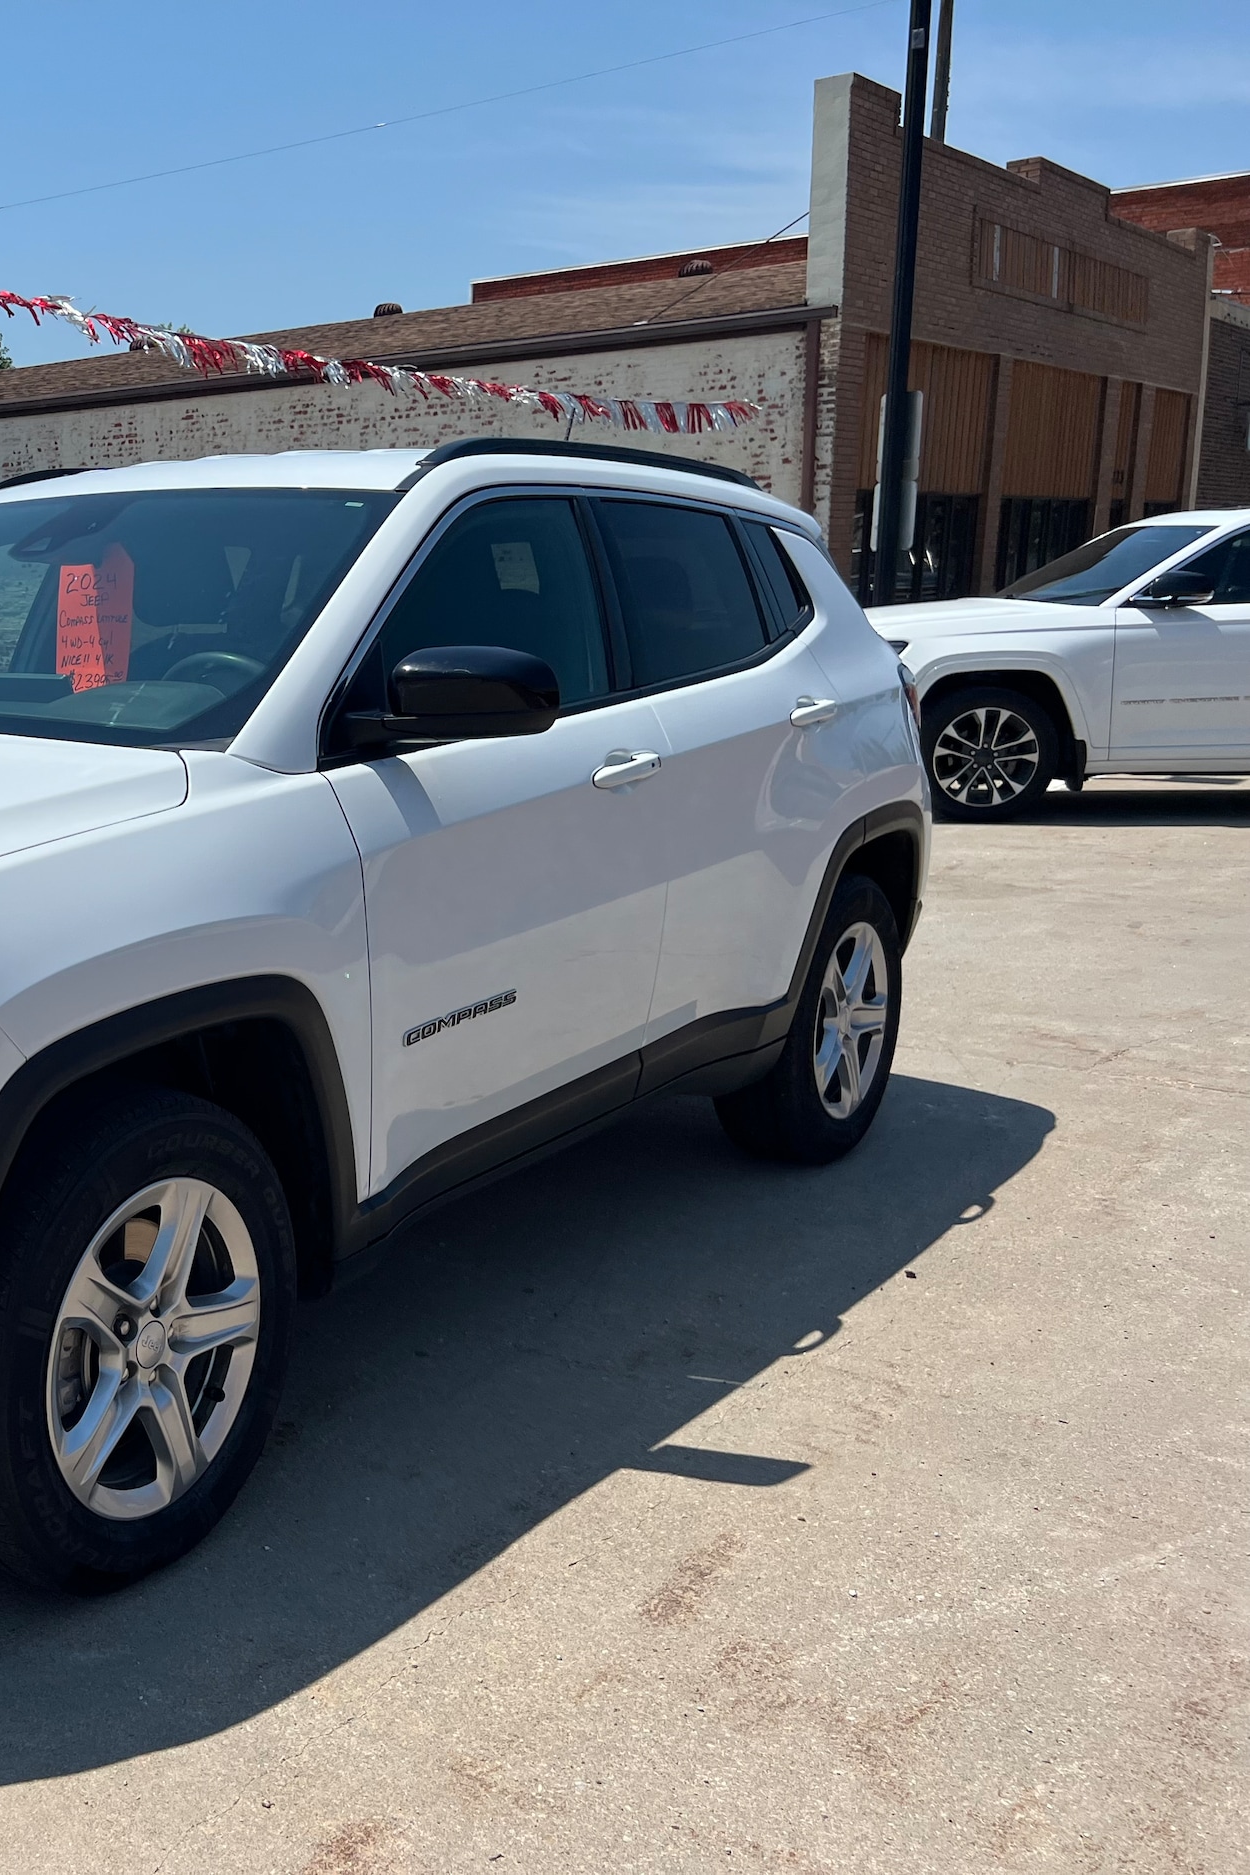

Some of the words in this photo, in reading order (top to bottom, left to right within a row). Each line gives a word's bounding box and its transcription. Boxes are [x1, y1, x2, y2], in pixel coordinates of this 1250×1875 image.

[66, 573, 117, 594] 2024
[80, 592, 109, 607] JEEP
[402, 988, 517, 1047] COMPASS
